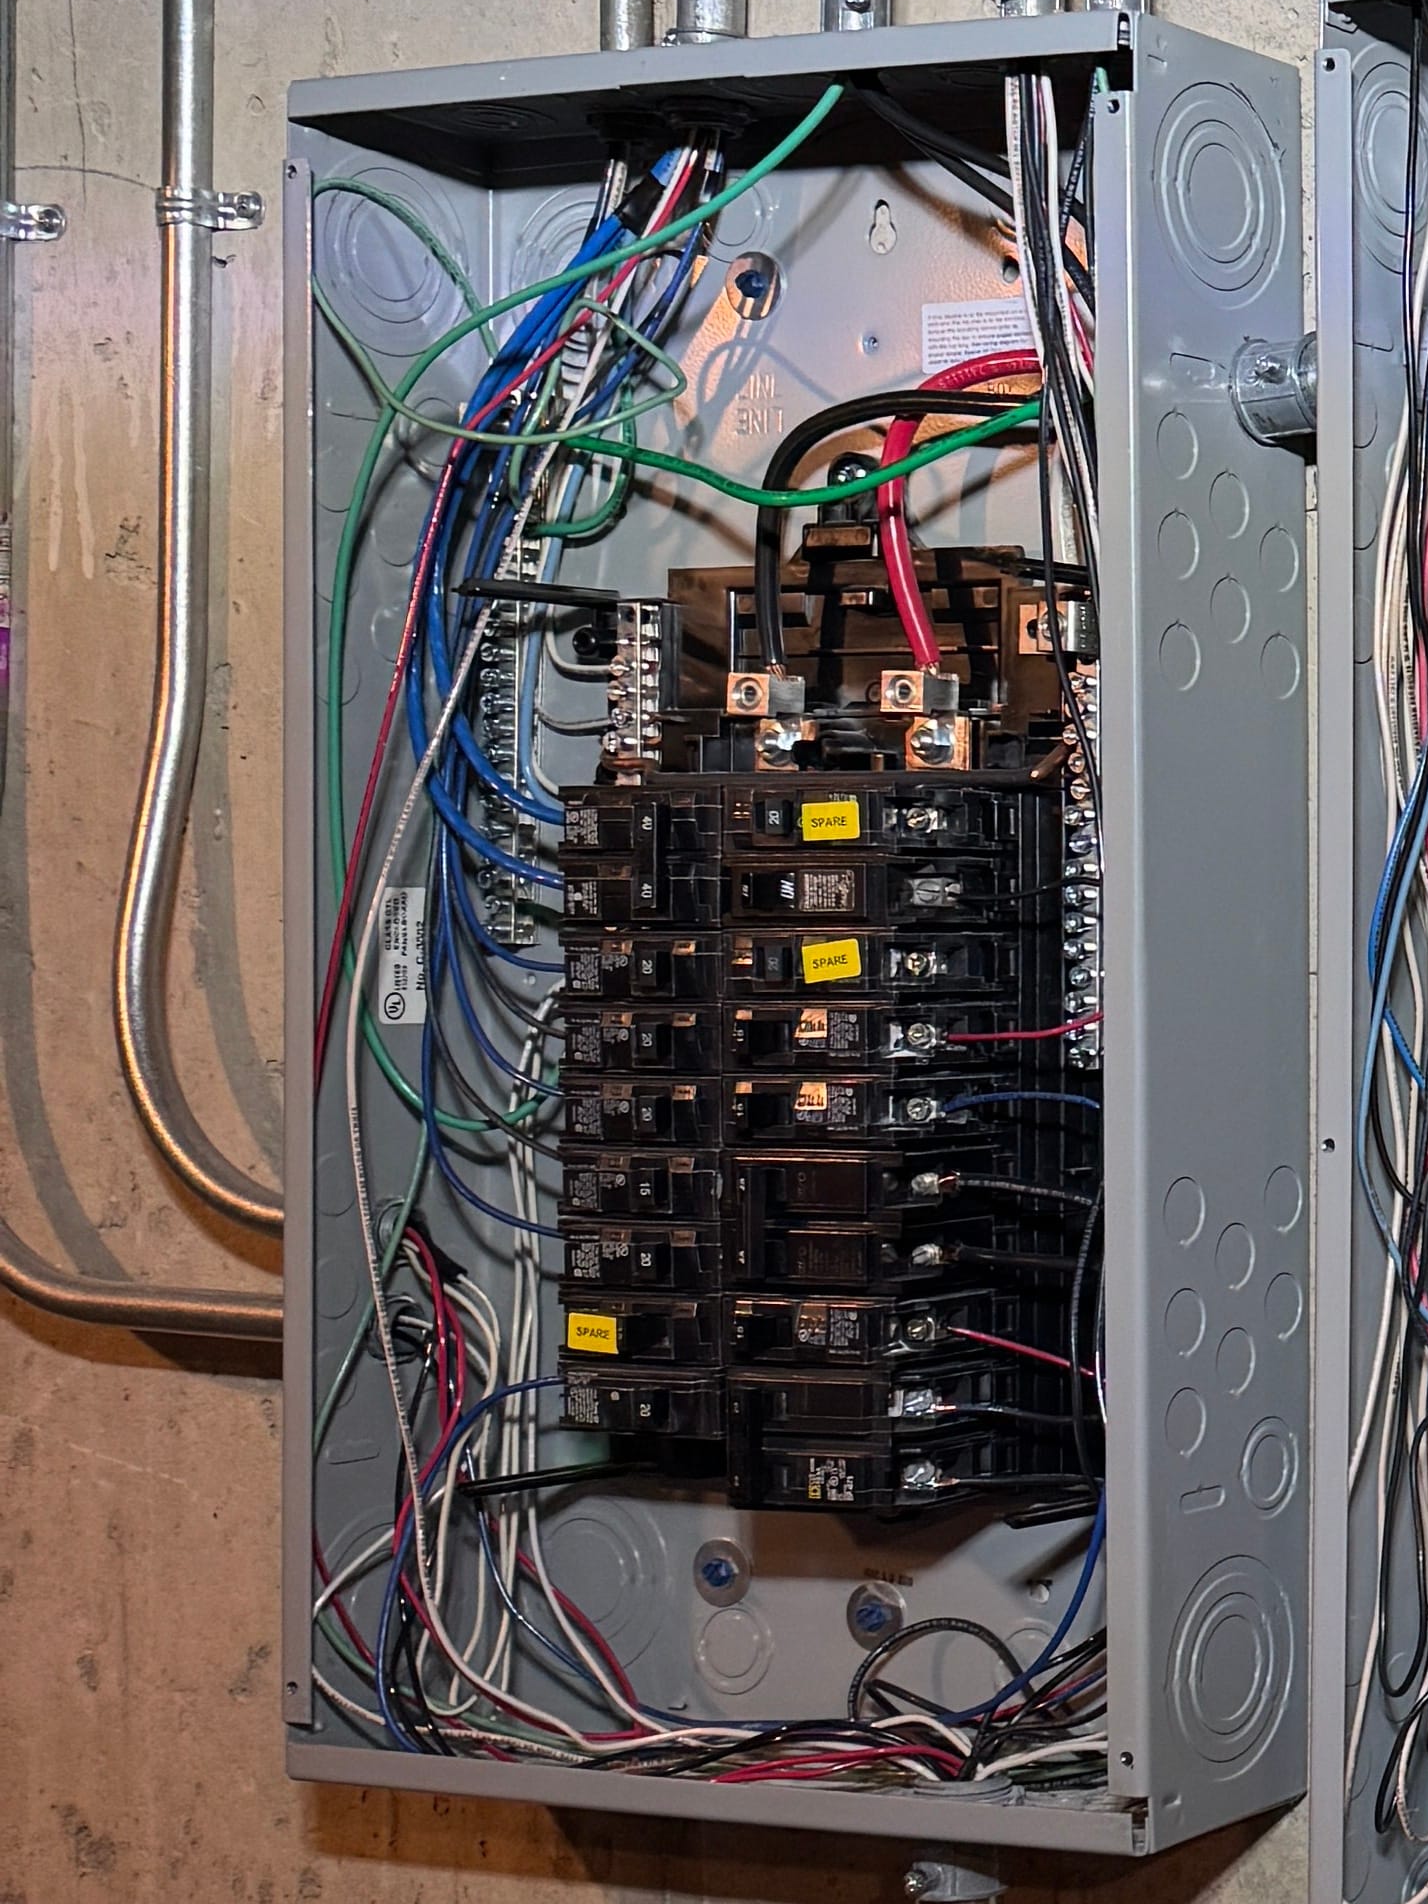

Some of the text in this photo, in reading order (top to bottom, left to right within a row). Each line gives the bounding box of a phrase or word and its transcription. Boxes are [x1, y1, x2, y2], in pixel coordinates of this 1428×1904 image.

[768, 810, 780, 826] 20
[810, 816, 847, 828] SPARE
[641, 959, 653, 975] 20
[811, 954, 848, 970] SPARE
[641, 1032, 653, 1048] 20
[641, 1106, 653, 1122] 20
[640, 1252, 652, 1267] 20
[574, 1325, 611, 1342] SPARE
[639, 1403, 651, 1418] 20
